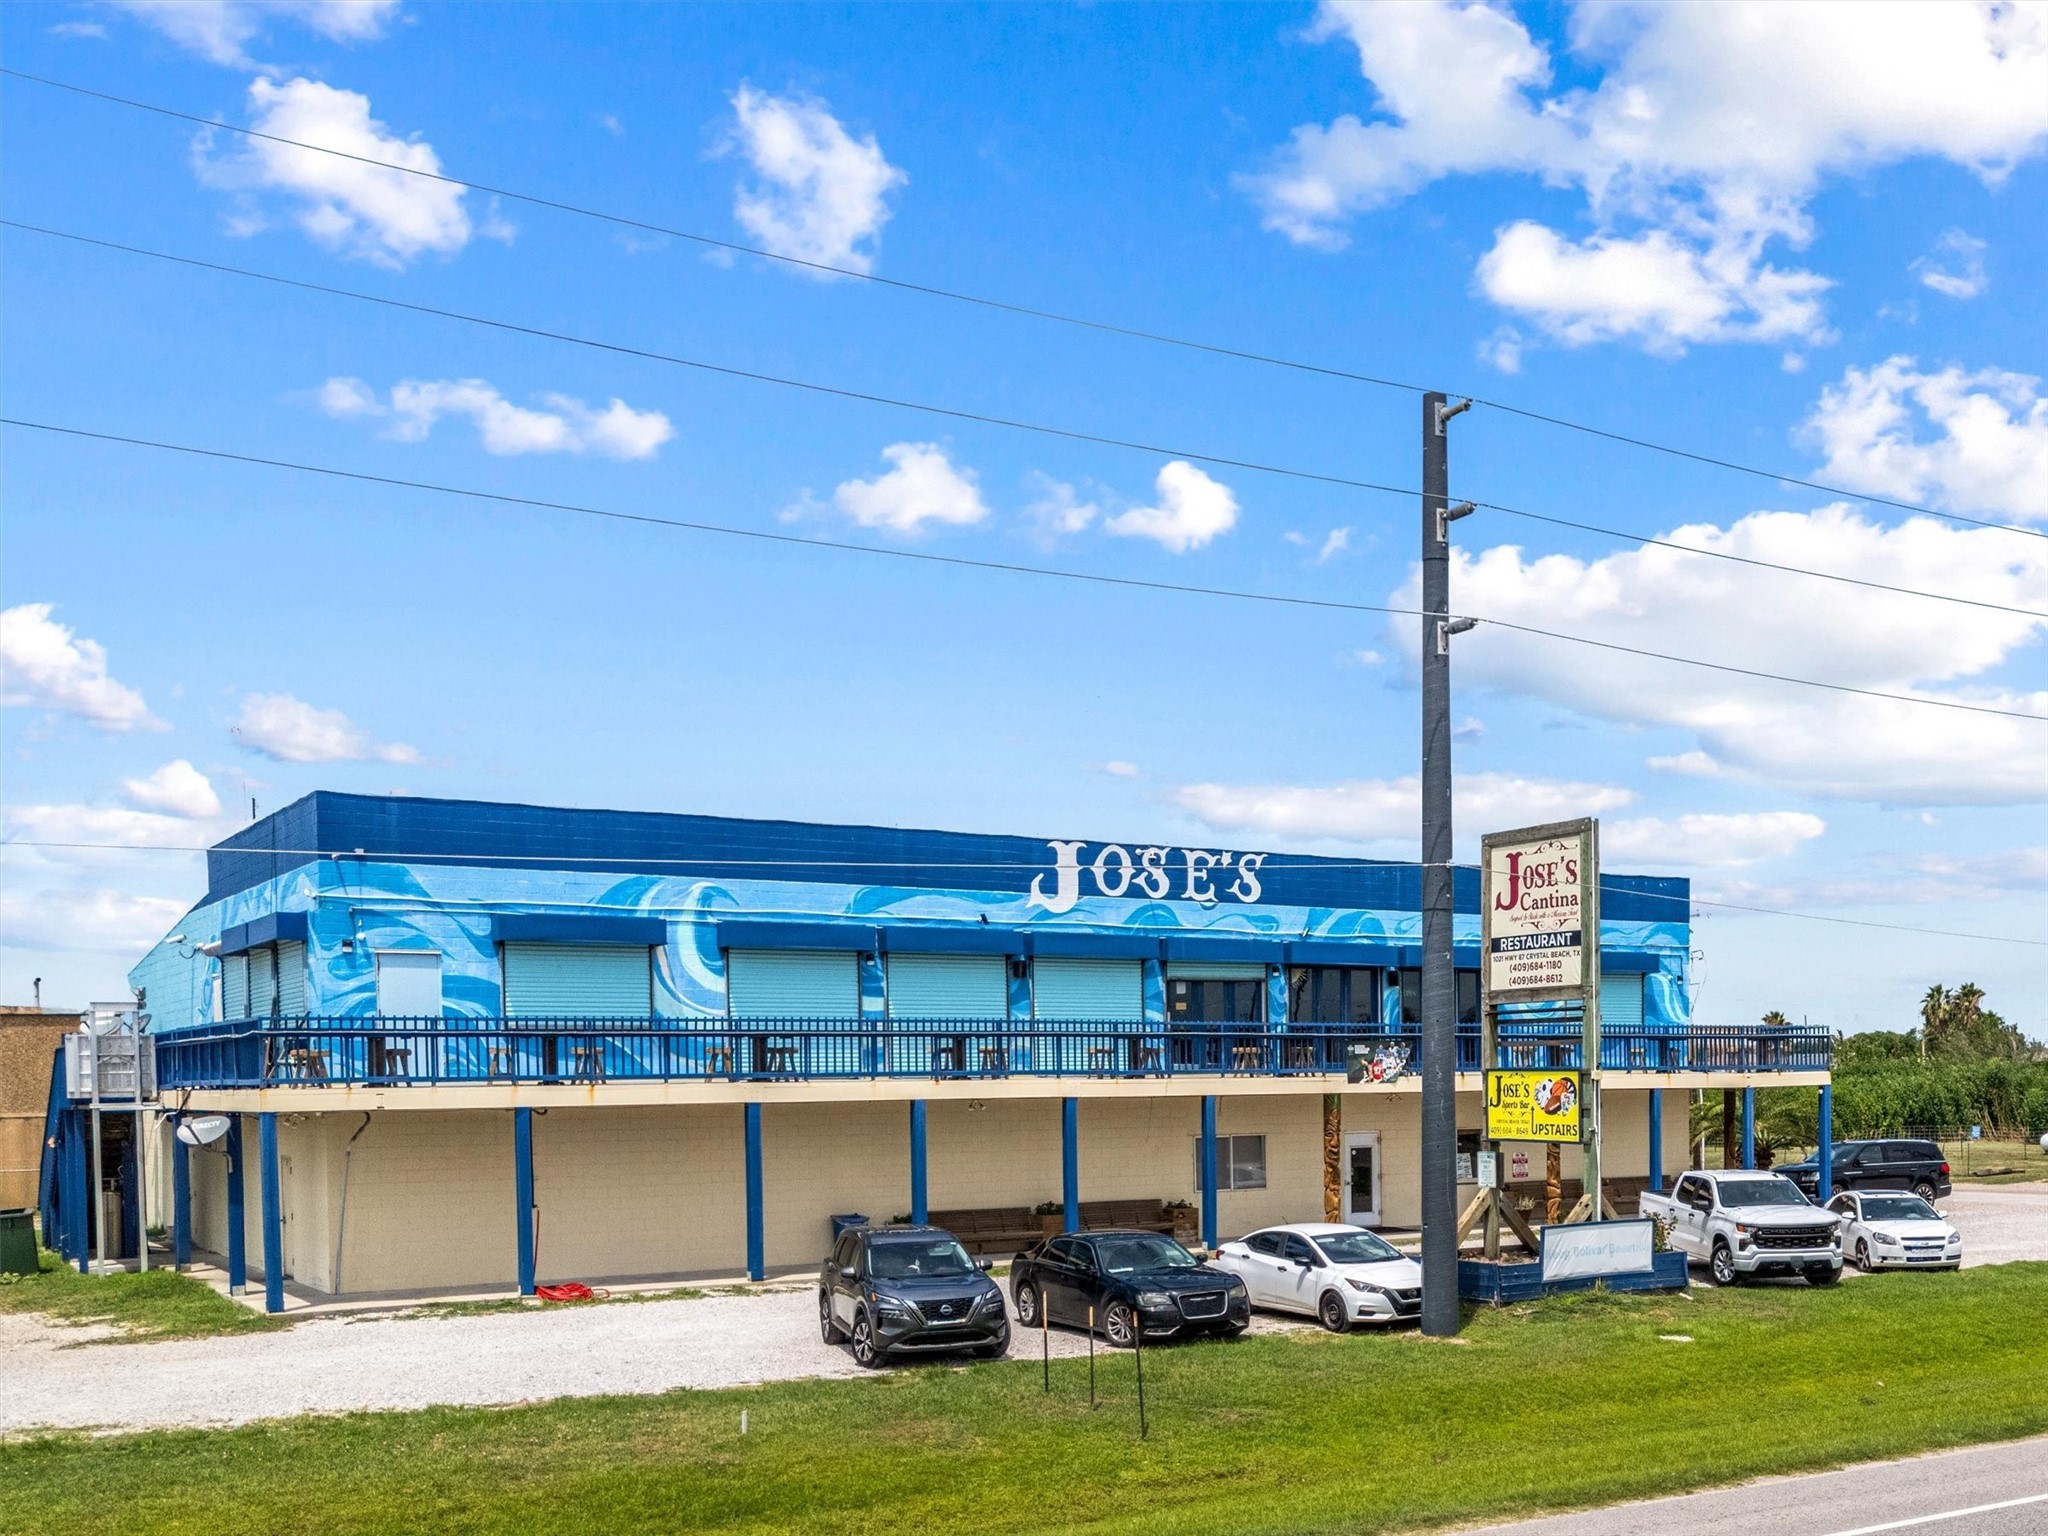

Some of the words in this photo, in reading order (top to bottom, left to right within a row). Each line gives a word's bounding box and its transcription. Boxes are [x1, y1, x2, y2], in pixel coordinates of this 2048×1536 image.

[1025, 840, 1268, 914] JOSE'S
[1494, 851, 1578, 911] JOSE'S
[1520, 889, 1579, 911] Cantina
[1500, 932, 1573, 951] RESTAURANT
[1504, 954, 1518, 962] HWY
[1526, 952, 1549, 960] CRYSTAL
[1550, 950, 1571, 958] BEACH,
[1509, 960, 1562, 973] (409)684-1180
[1508, 973, 1563, 987] (409)684-8612
[1489, 1075, 1530, 1108] JOSE'S
[1501, 1100, 1518, 1110] Sports
[1519, 1100, 1530, 1109] Bar
[1531, 1123, 1578, 1136] UPSTAIRS
[1762, 1227, 1827, 1235] CHEVROLET
